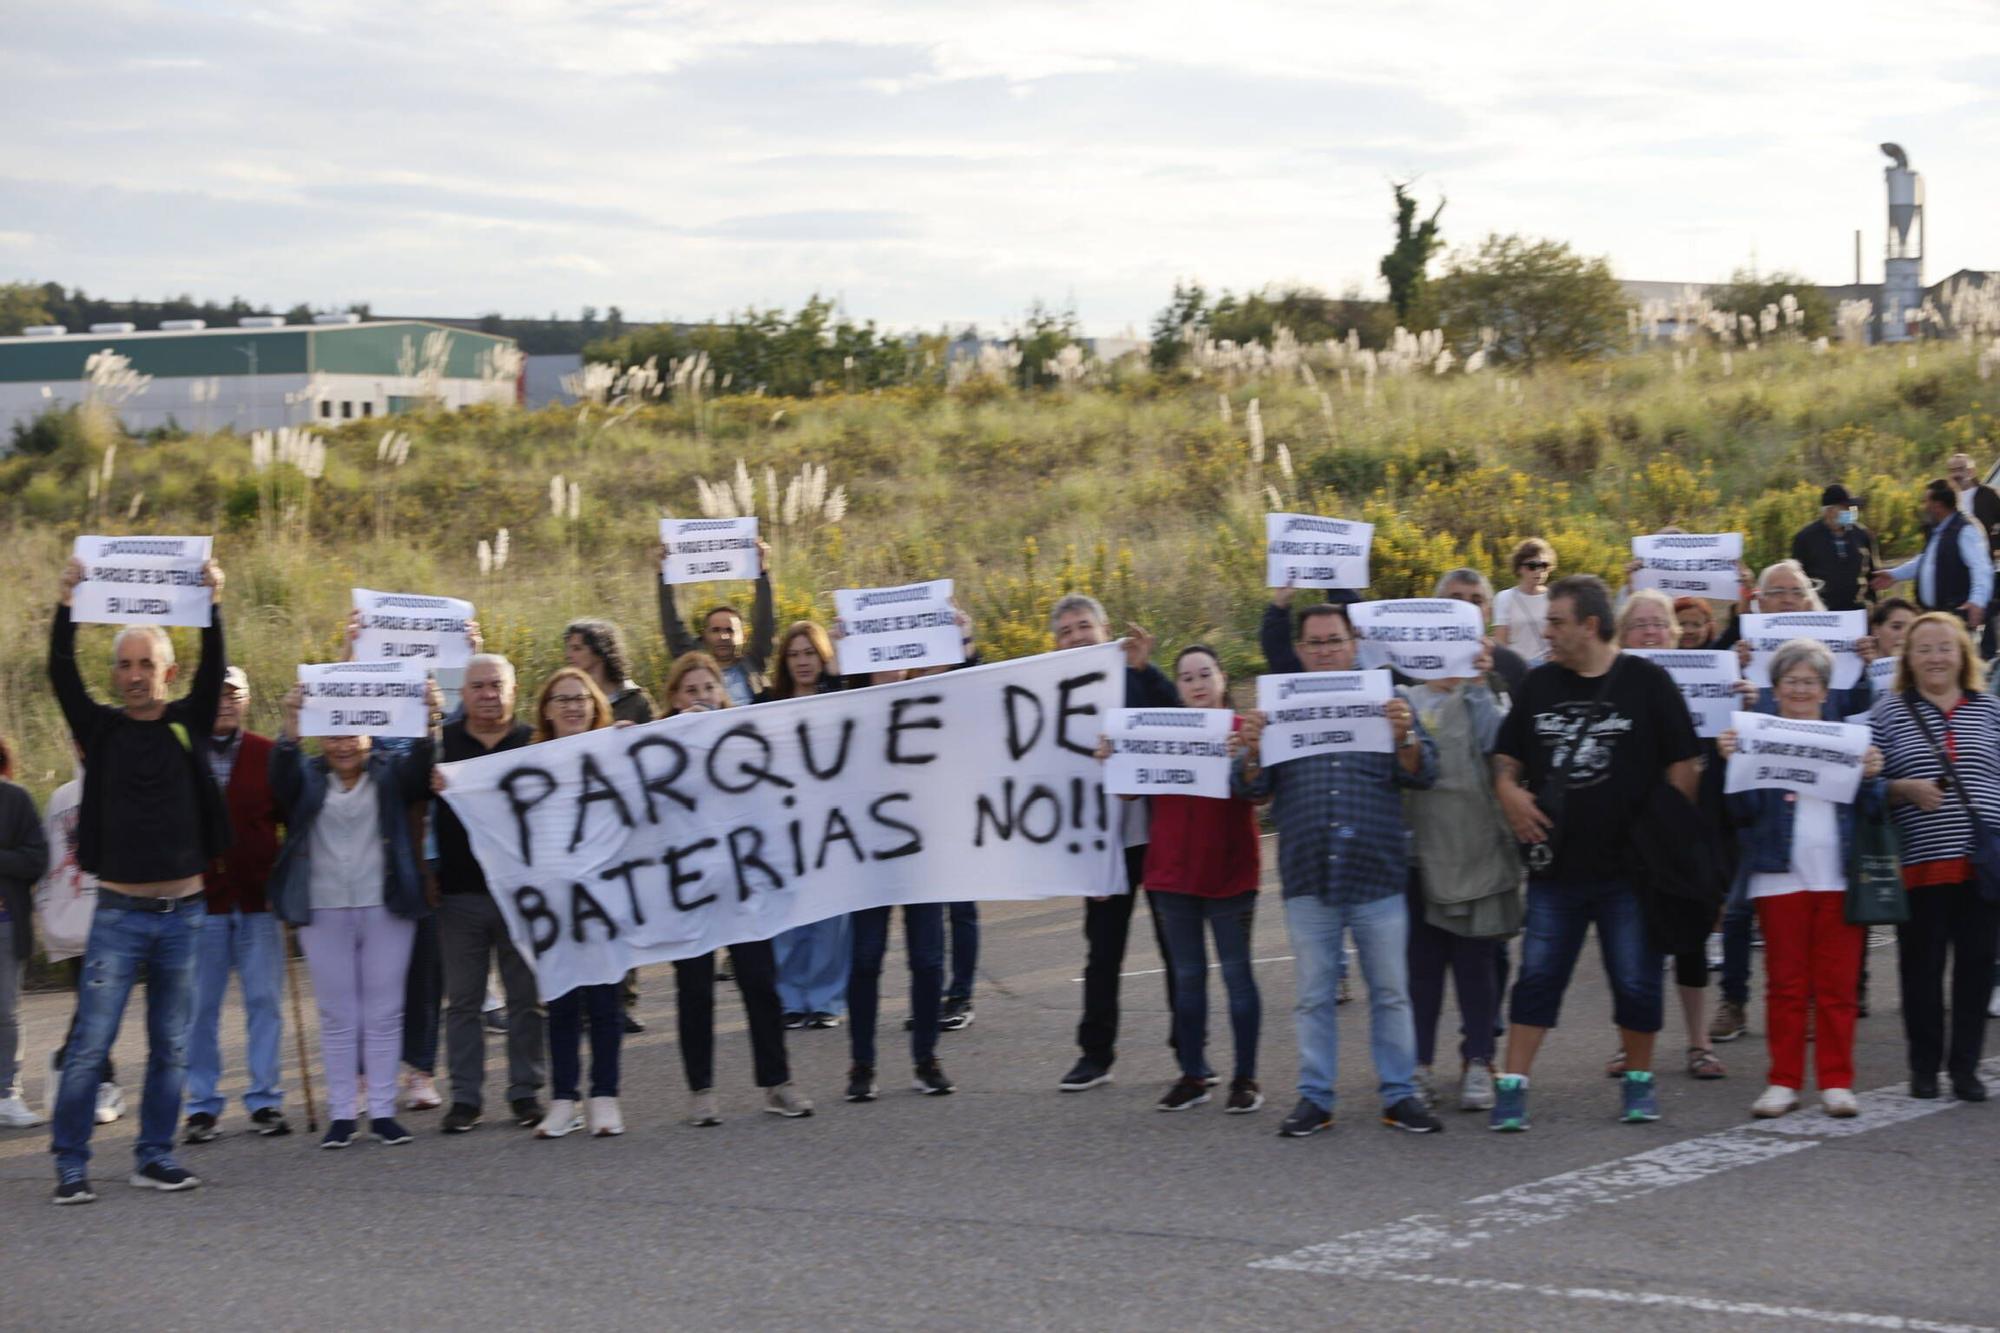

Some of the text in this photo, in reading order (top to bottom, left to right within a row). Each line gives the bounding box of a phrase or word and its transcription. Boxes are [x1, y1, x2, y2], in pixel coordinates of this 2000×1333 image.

[499, 671, 1107, 866] PARQUE DE
[974, 777, 1107, 856] NO!!
